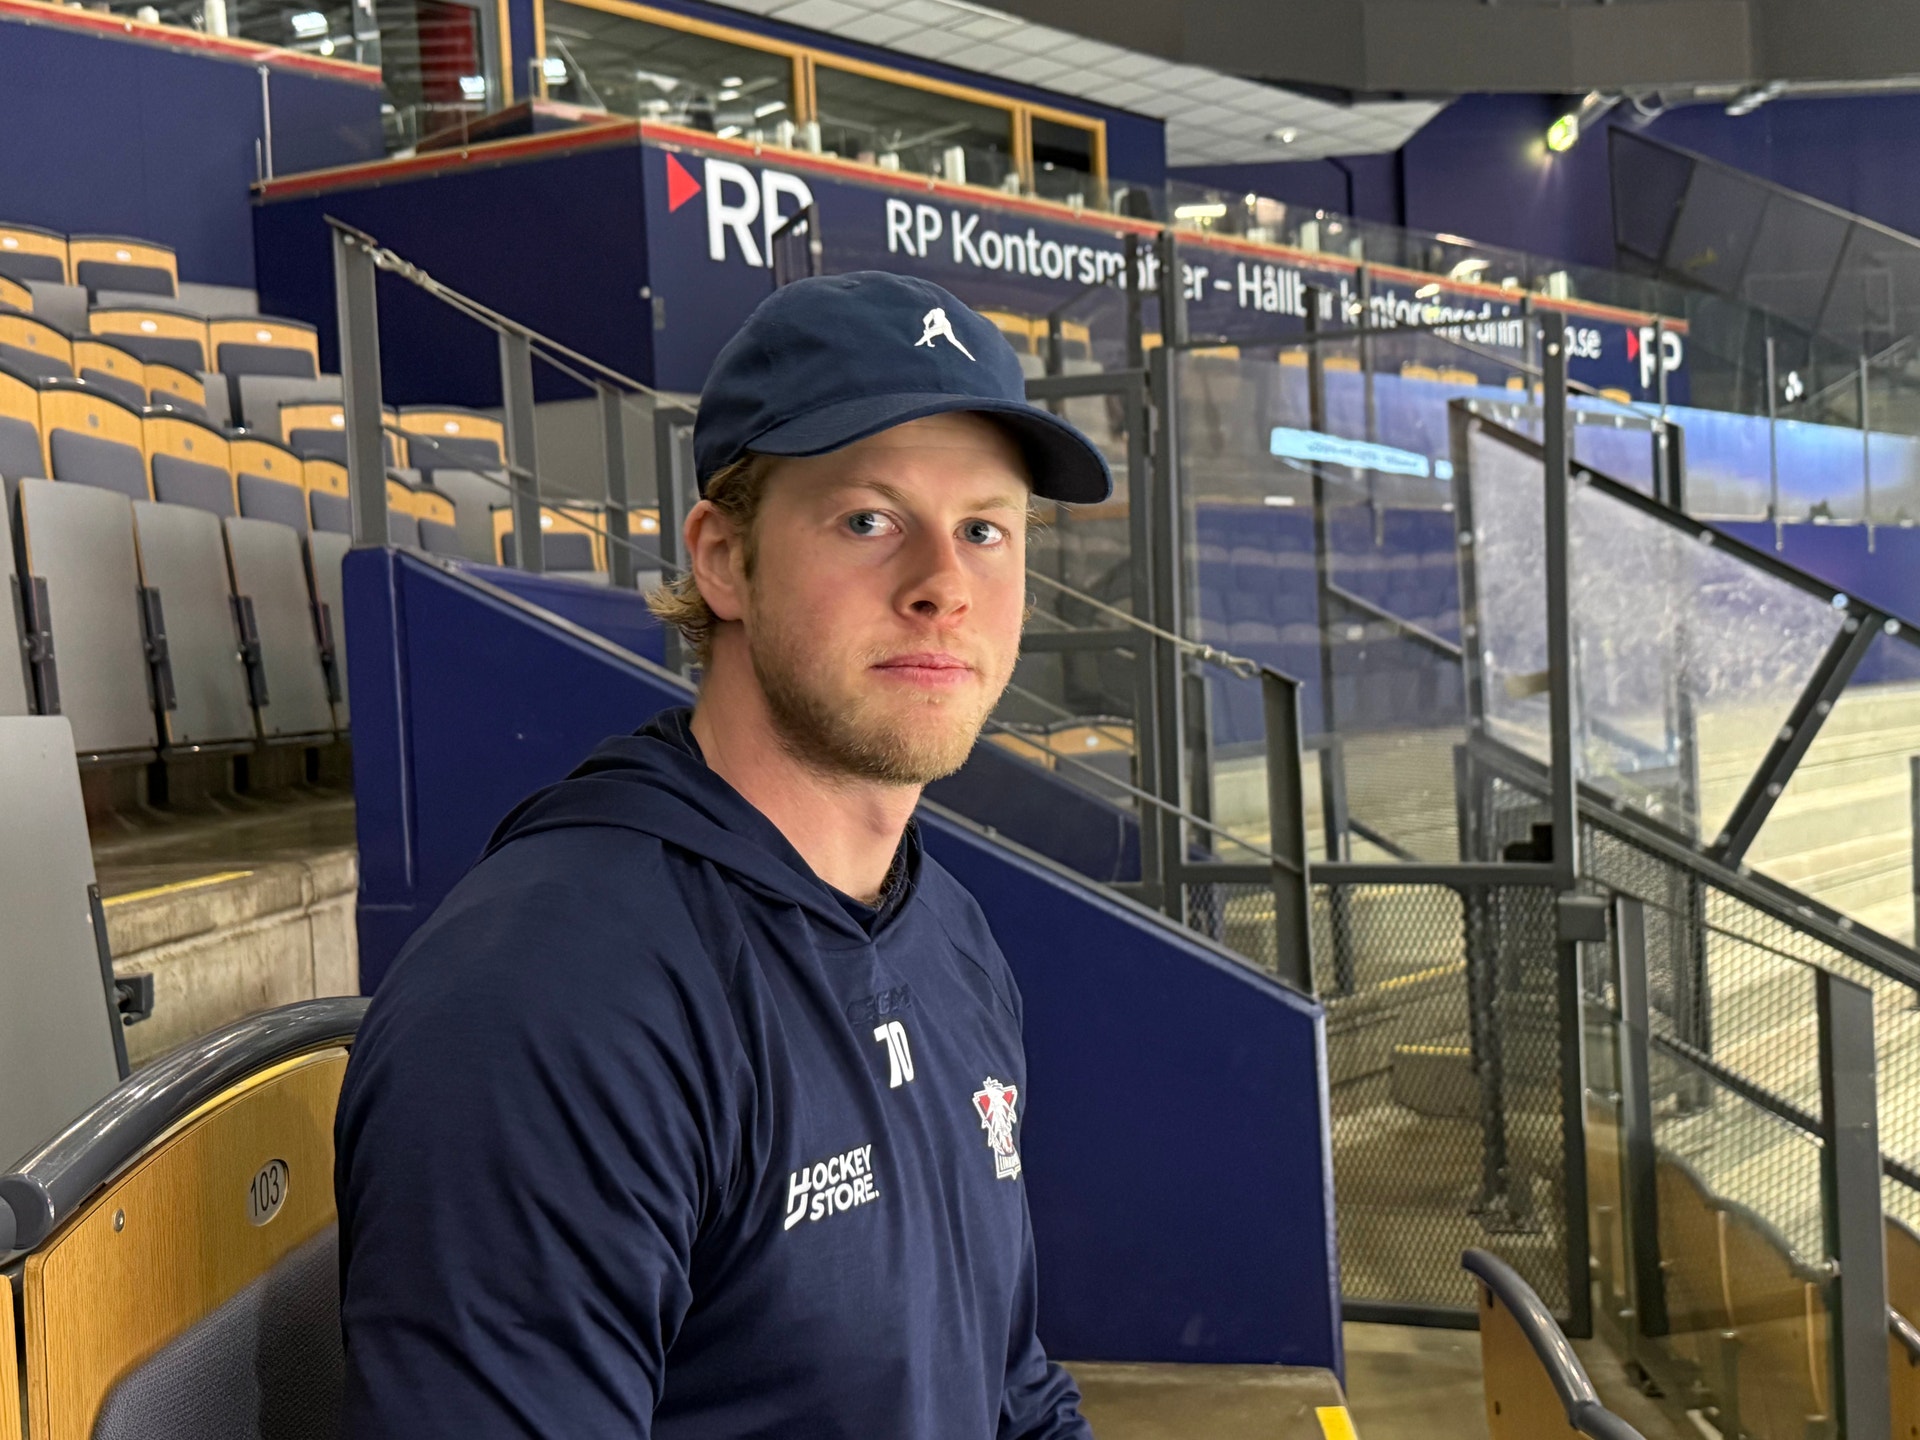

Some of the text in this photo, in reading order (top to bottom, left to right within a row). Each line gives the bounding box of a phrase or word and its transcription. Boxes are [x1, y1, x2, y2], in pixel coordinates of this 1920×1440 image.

[704, 157, 814, 269] RP
[886, 198, 943, 258] RP
[1237, 261, 1333, 321] Hållbr
[873, 1020, 915, 1089] 70
[250, 1165, 280, 1217] 103
[784, 1143, 872, 1231] HOCKEY
